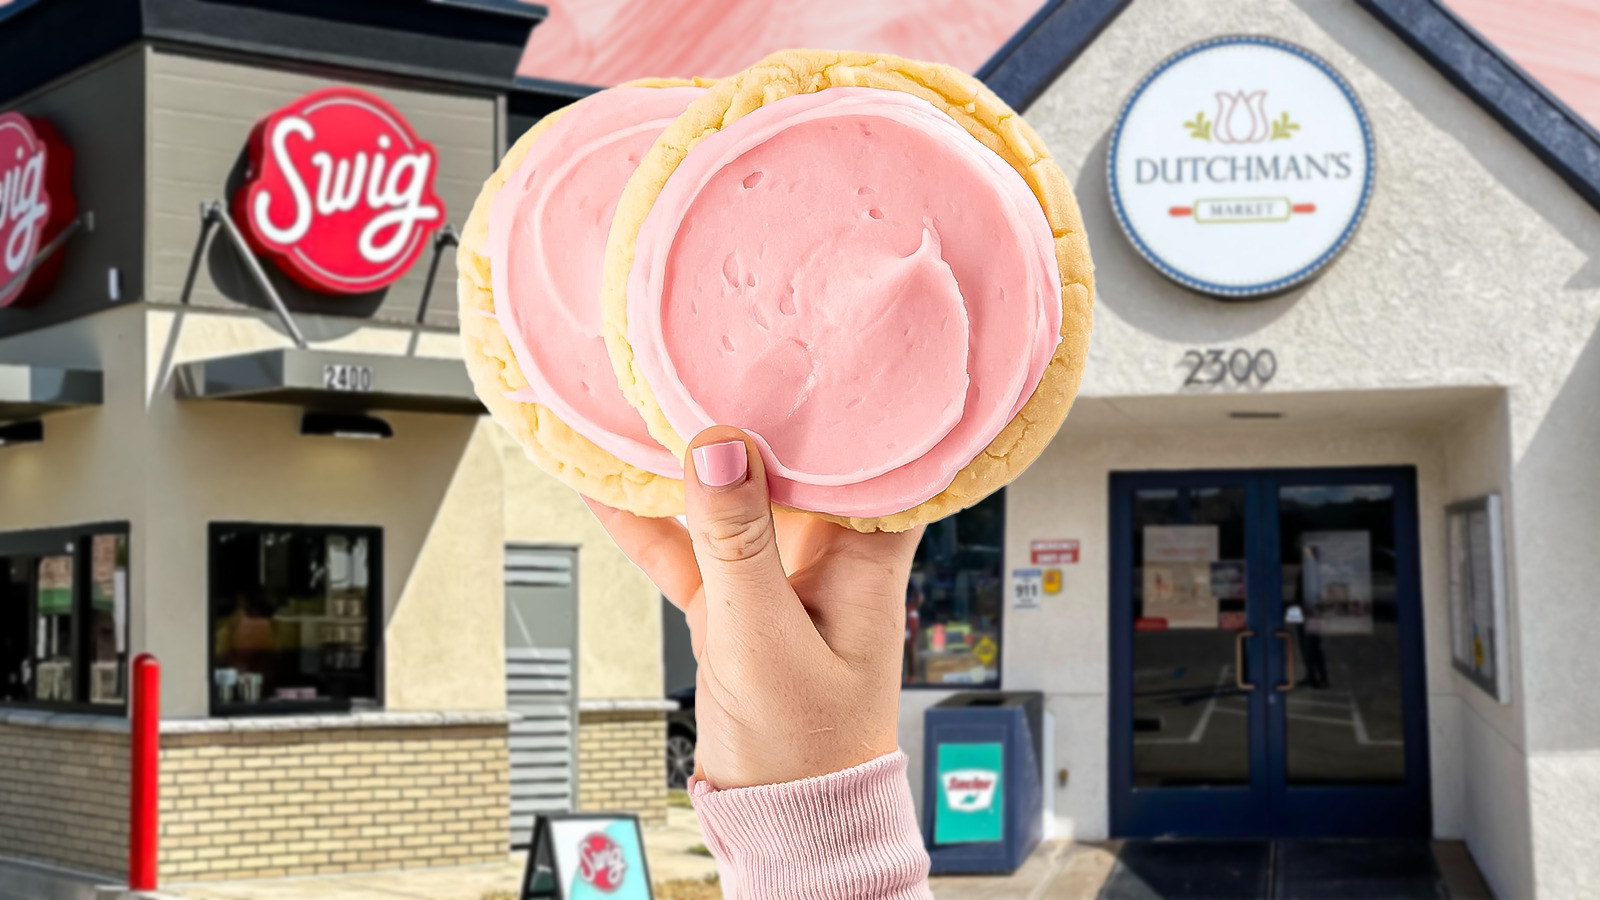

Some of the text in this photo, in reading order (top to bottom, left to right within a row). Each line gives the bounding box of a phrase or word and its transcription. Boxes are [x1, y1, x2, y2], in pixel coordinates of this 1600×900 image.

[1135, 152, 1352, 185] DUTCHMAN'S
[254, 116, 439, 263] Swig
[1208, 201, 1276, 217] MARKET
[325, 365, 373, 391] 2400
[1183, 347, 1277, 386] 2300
[1015, 583, 1038, 598] 911
[579, 841, 627, 885] Swig
